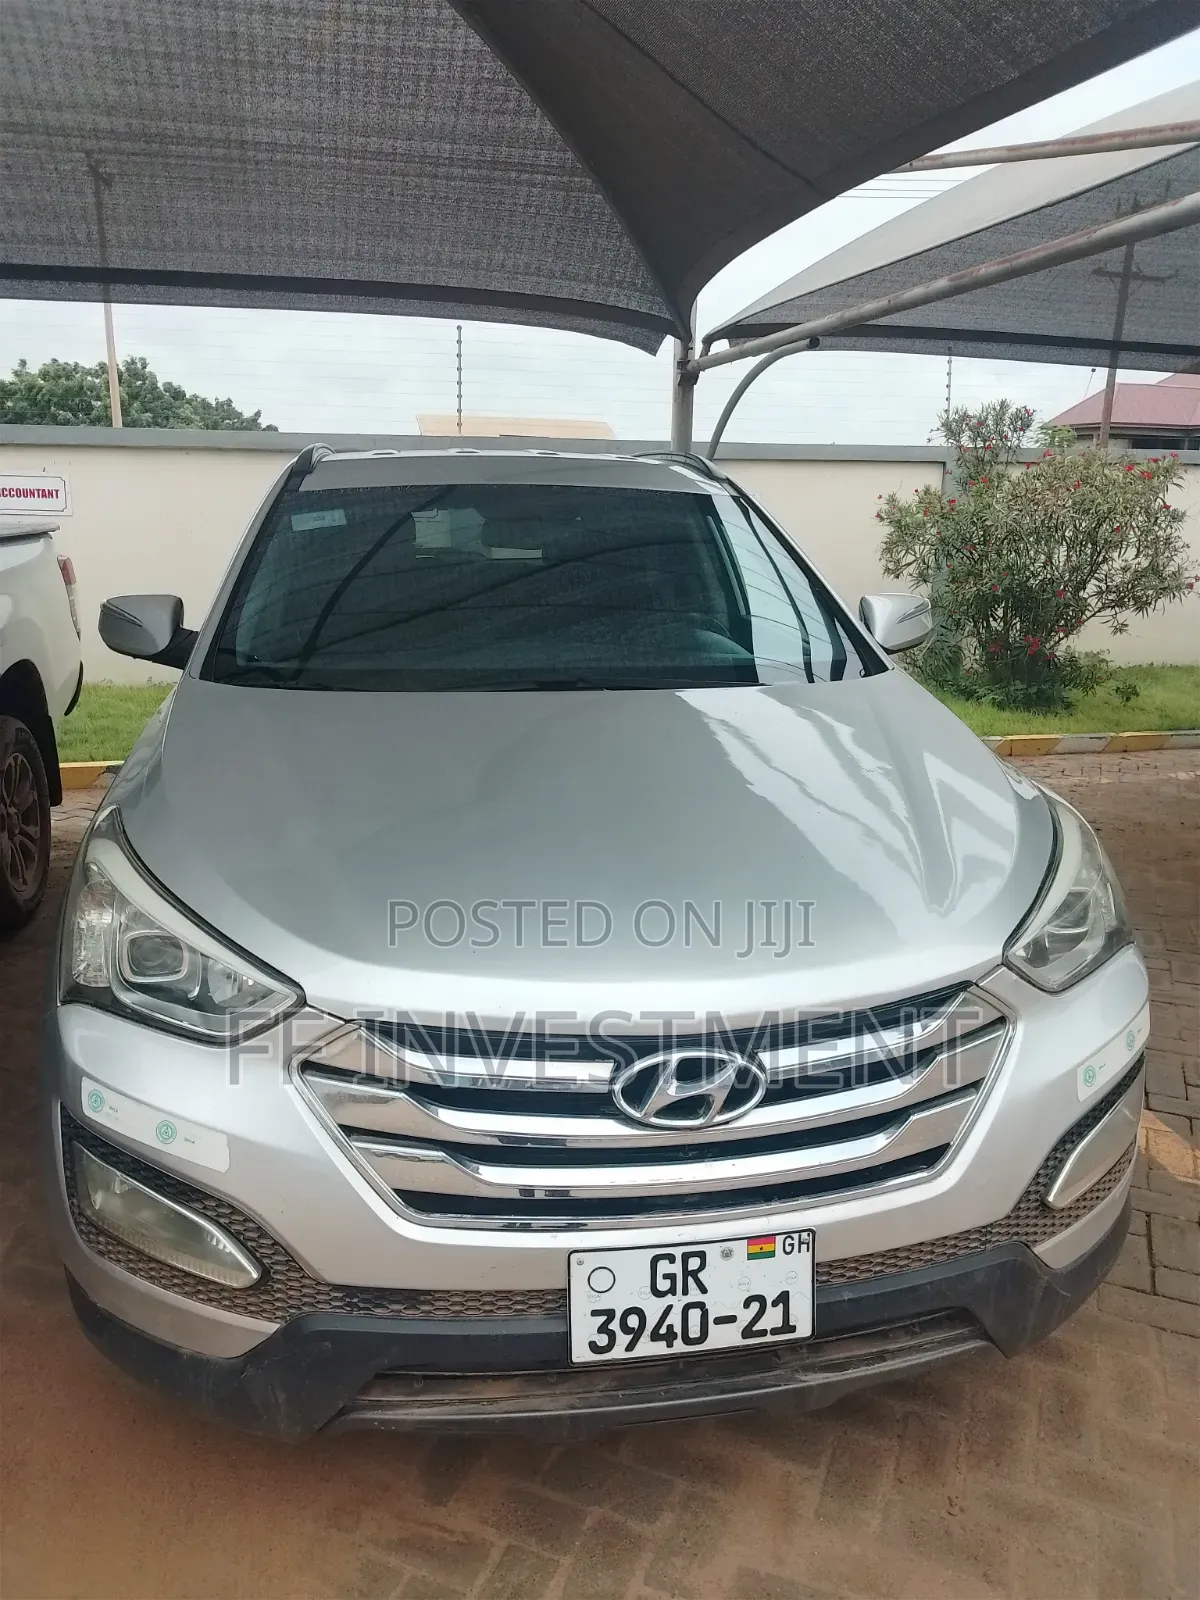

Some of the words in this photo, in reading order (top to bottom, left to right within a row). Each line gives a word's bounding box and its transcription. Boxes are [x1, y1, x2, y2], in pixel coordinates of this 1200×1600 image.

[0, 487, 60, 499] CCOUNTANT
[650, 1250, 708, 1298] GR
[782, 1232, 811, 1256] GH
[588, 1290, 797, 1355] 3940-21
